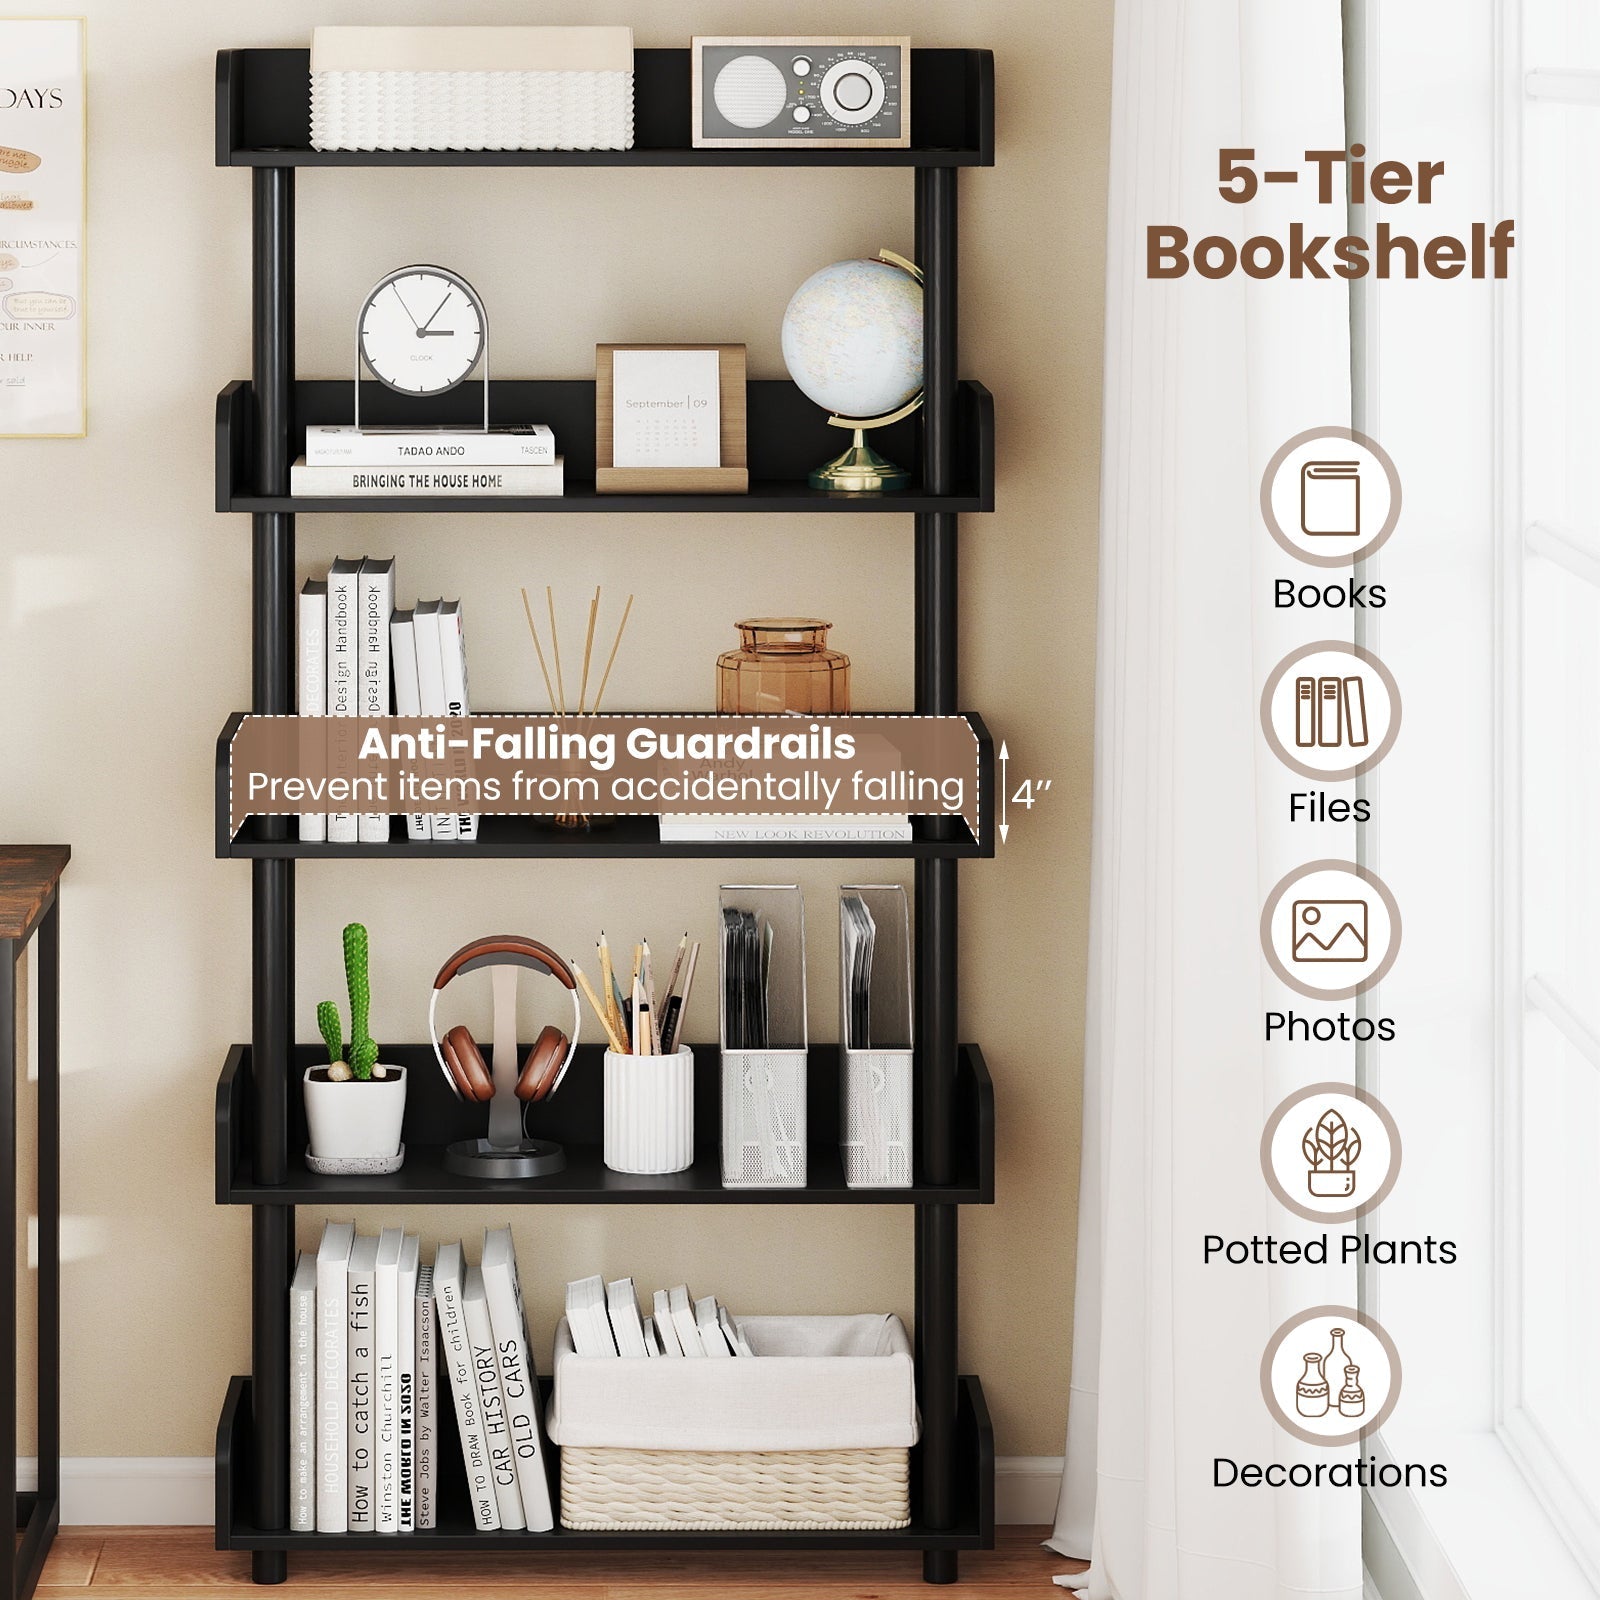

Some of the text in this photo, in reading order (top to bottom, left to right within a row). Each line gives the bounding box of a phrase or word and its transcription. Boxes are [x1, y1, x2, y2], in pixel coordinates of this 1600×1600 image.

[626, 399, 708, 410] September 09
[398, 446, 466, 456] TADAO ANDO
[353, 475, 503, 488] BRINGING THE HOUSE HOME
[335, 585, 348, 653] Handbook
[306, 628, 320, 713] DECORATES
[335, 661, 351, 712] Design
[715, 829, 905, 839] NEW LOOK REVOLUTION
[298, 1295, 308, 1326] house
[298, 1330, 307, 1348] the
[324, 1299, 340, 1494] HOUSEHOLD DECORATES
[351, 1284, 369, 1522] How to catch a fish
[420, 1301, 431, 1525] Steve Jobs by Walter Isaacson
[443, 1286, 493, 1525] HOW TO DRAW Book for children
[473, 1346, 514, 1486] CAR HISTORY
[499, 1339, 536, 1459] OLD CARS
[299, 1441, 308, 1454] an
[381, 1355, 392, 1522] Winston Churchill
[298, 1505, 308, 1525] How
[299, 1488, 308, 1500] to
